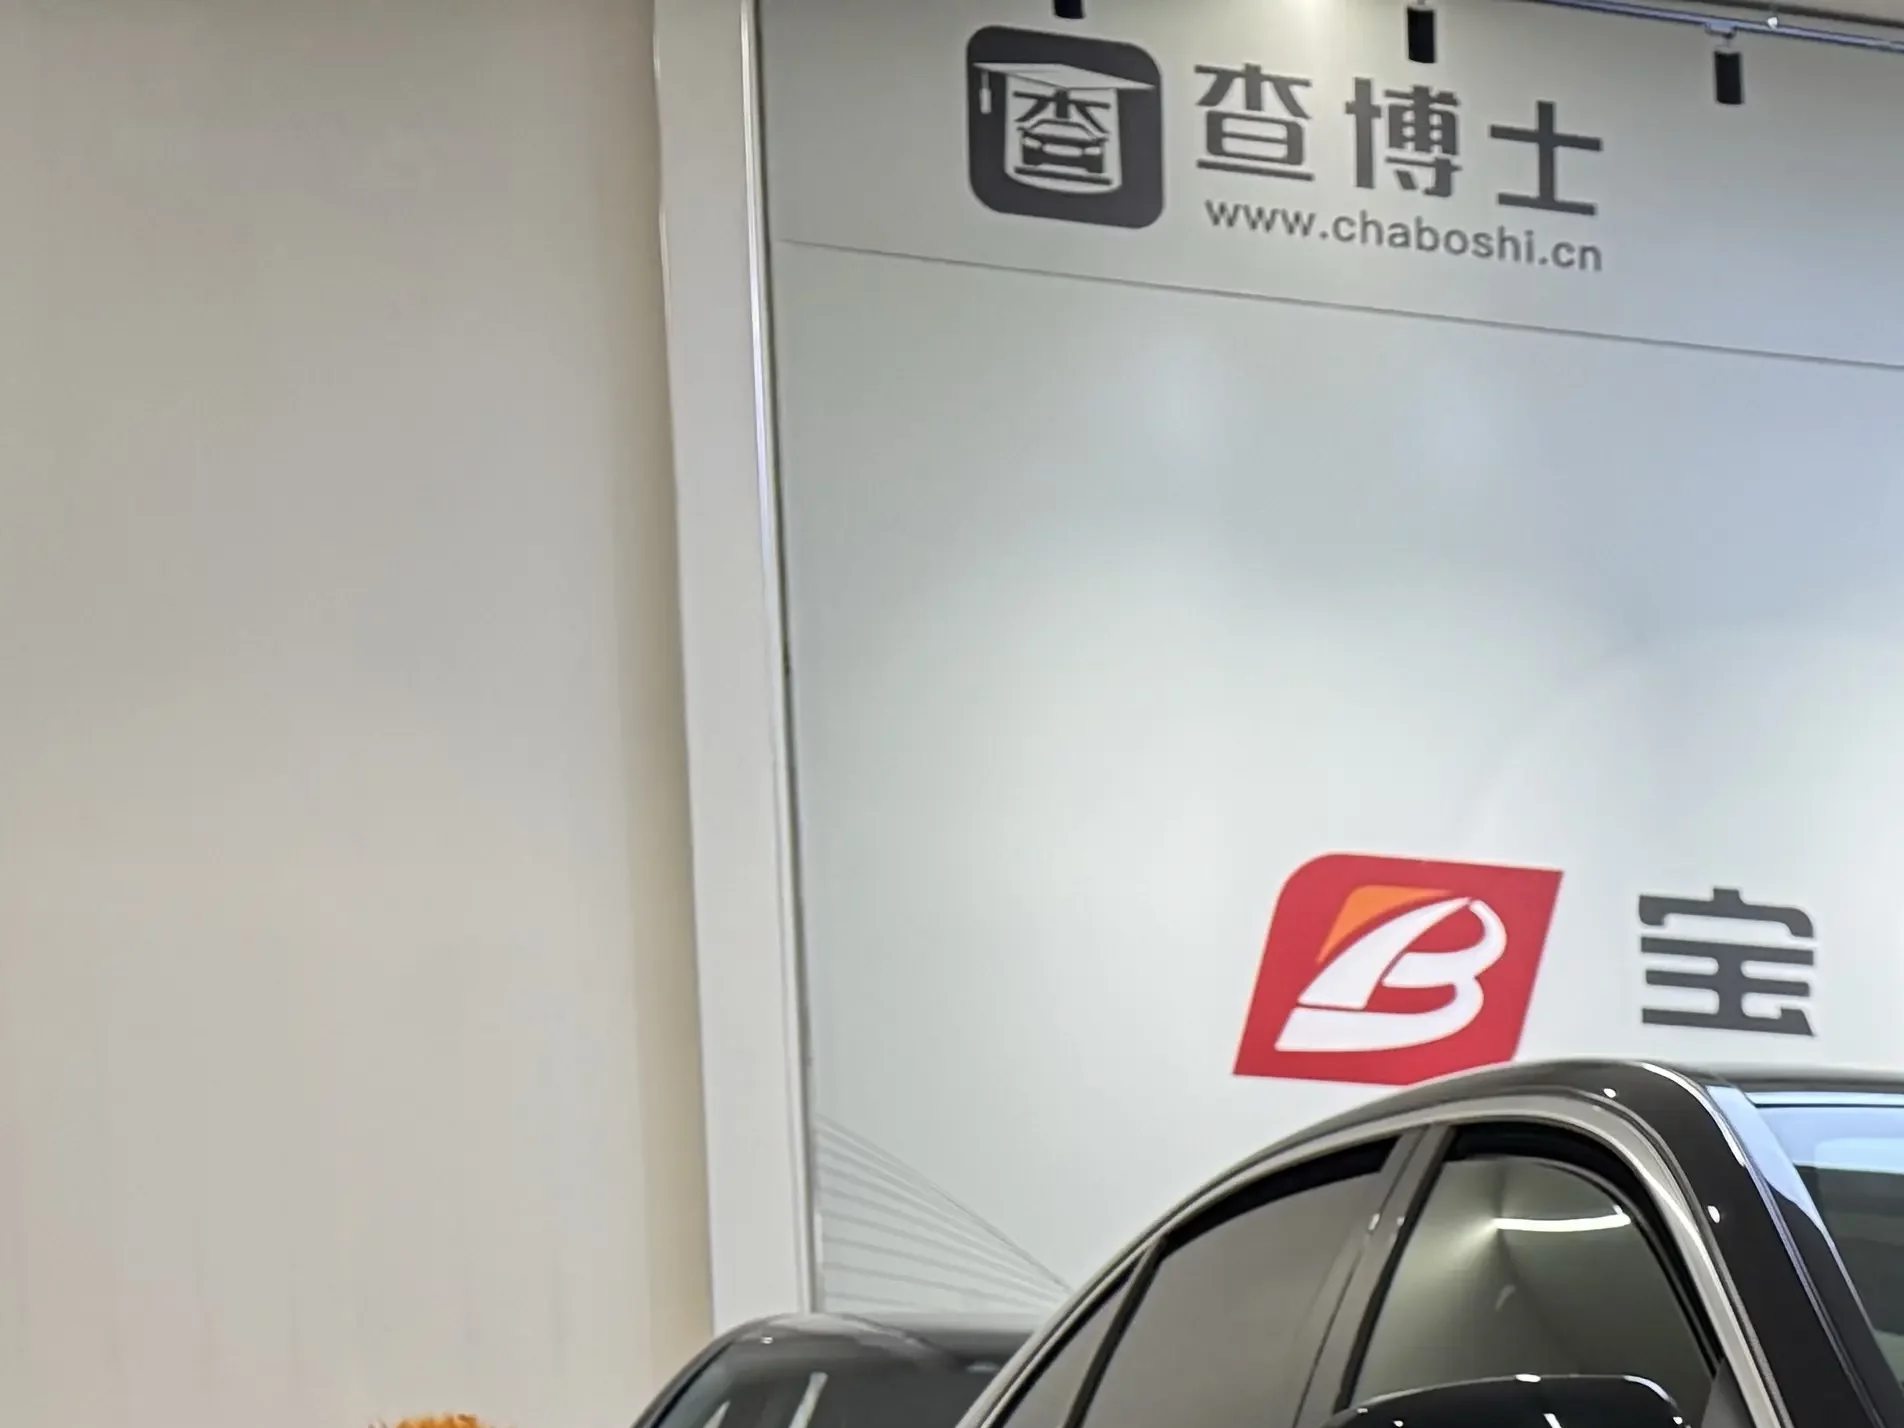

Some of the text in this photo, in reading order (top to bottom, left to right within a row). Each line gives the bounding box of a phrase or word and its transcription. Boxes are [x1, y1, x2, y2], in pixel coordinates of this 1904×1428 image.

[1194, 63, 1604, 217] 查博士
[1204, 198, 1603, 273] www.chaboshi.cn
